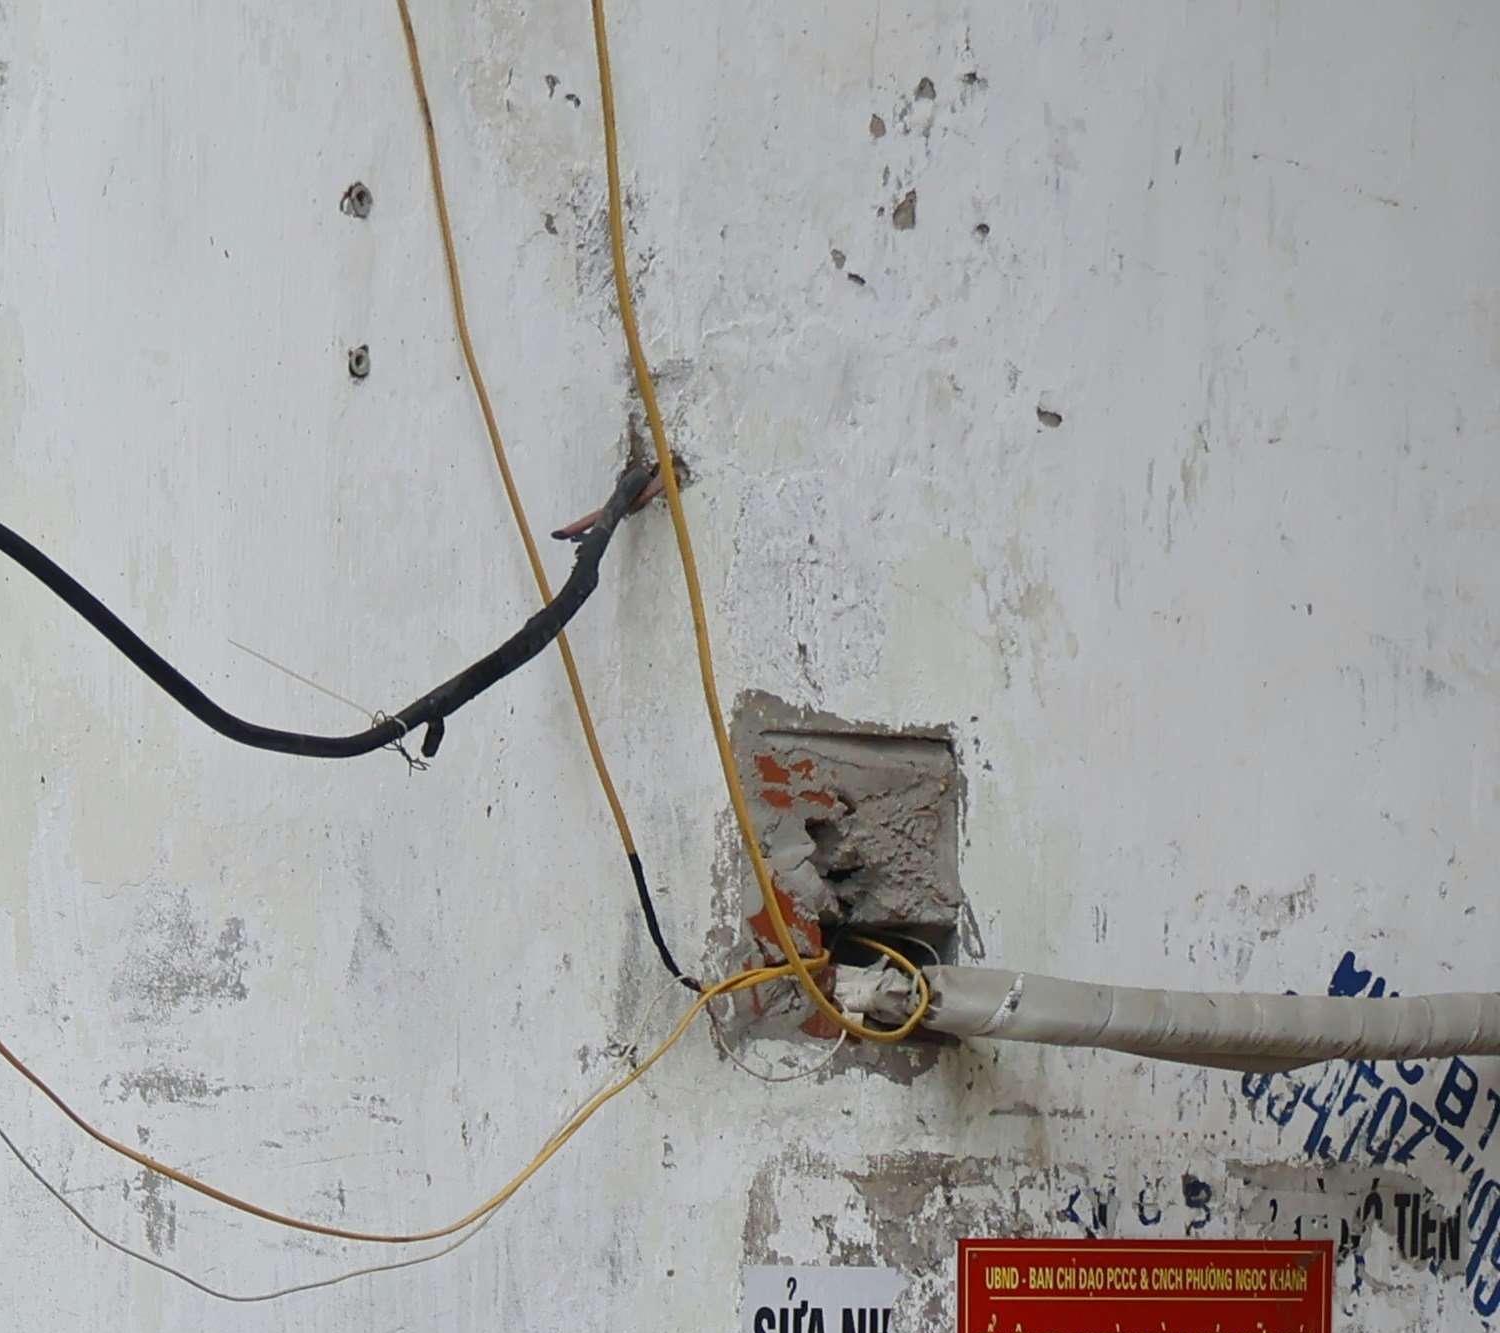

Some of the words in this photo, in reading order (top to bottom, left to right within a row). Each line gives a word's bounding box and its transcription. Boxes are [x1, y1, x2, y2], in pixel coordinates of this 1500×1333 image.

[985, 1267, 1019, 1290] UBND
[1029, 1267, 1053, 1290] BAN
[1057, 1257, 1077, 1290] CHỈ
[1079, 1267, 1104, 1298] ĐẠO
[1107, 1267, 1137, 1290] PCCC
[1140, 1267, 1149, 1290] &
[1152, 1268, 1183, 1290] CNCH
[1186, 1261, 1233, 1291] PHƯỜNG
[1236, 1268, 1267, 1298] NGỌC
[1270, 1263, 1308, 1291] KHÁNH
